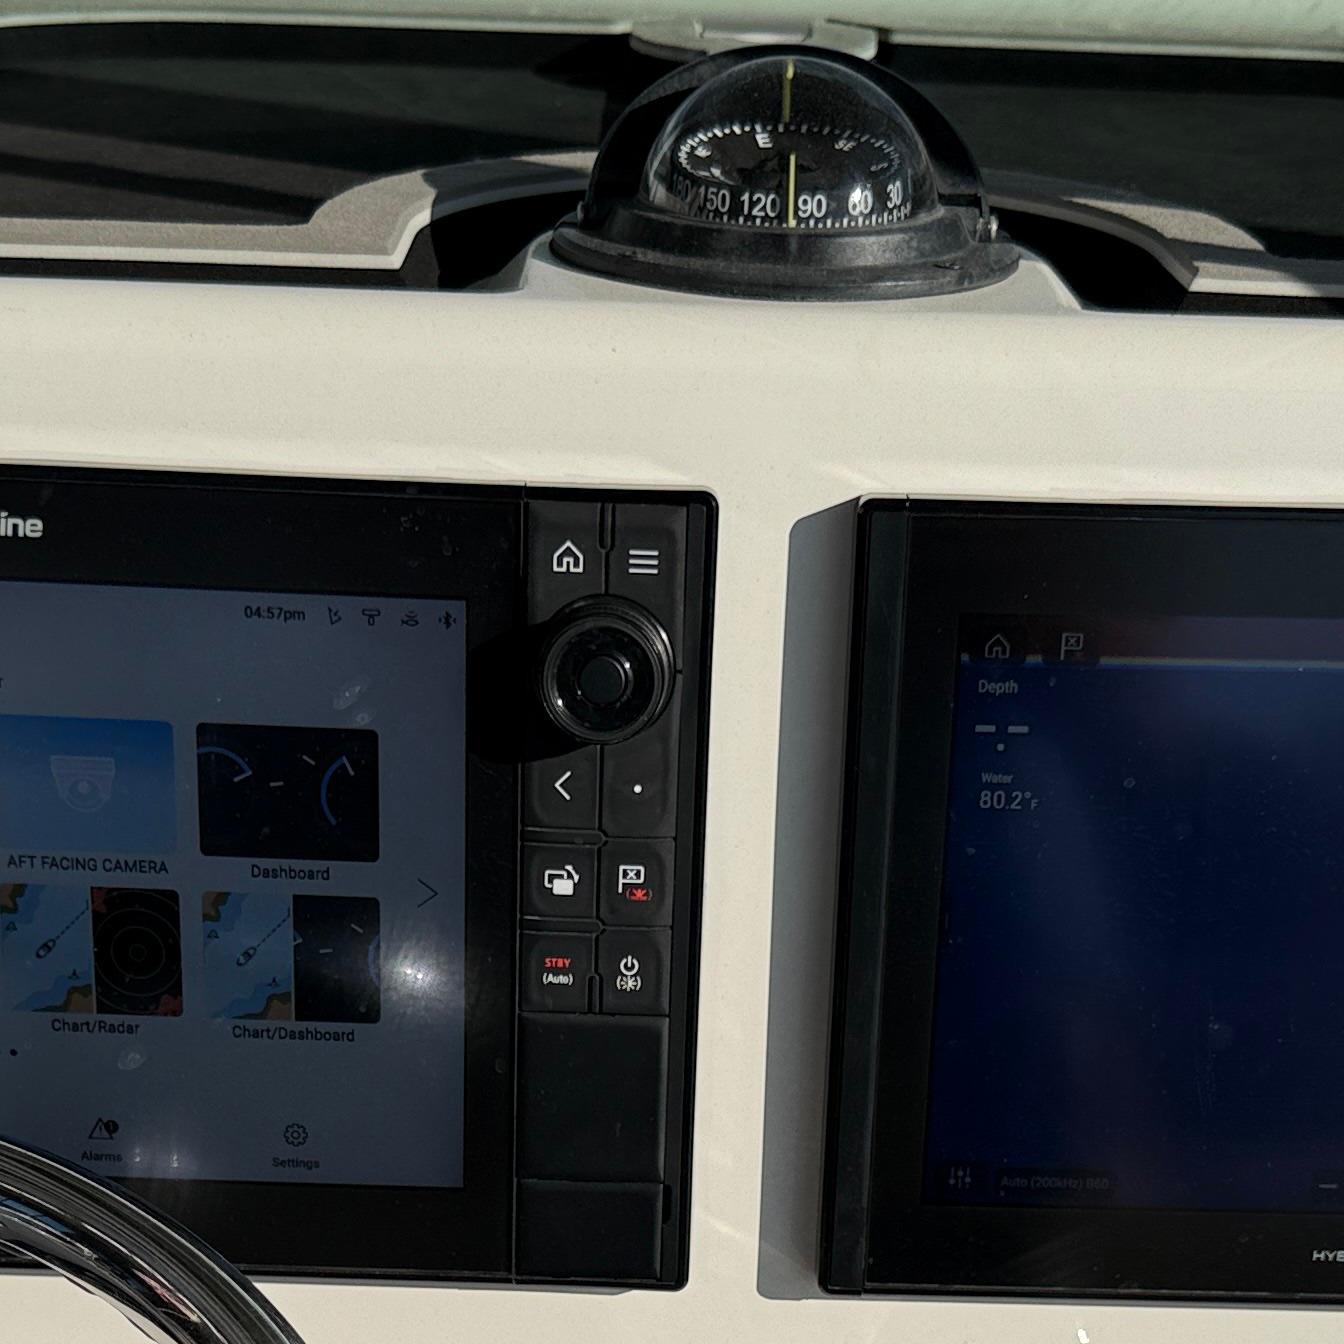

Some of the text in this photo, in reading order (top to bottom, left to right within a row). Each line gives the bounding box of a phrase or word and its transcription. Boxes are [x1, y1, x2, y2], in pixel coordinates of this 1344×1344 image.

[755, 133, 773, 149] E
[739, 191, 780, 217] 120
[797, 194, 827, 218] 90
[886, 180, 903, 209] 30
[243, 604, 306, 624] 04:57pm
[978, 679, 1019, 697] Depth
[981, 772, 1014, 784] Water
[6, 853, 169, 874] AFT FACING CAMERA
[250, 863, 331, 882] Dashboard
[544, 957, 571, 969] STBY
[542, 970, 574, 986] (Auto)
[51, 1018, 140, 1036] Chart/Radar
[231, 1024, 356, 1044] Chart/Dashboard
[80, 1151, 123, 1163] Alarms
[271, 1156, 320, 1170] Settings
